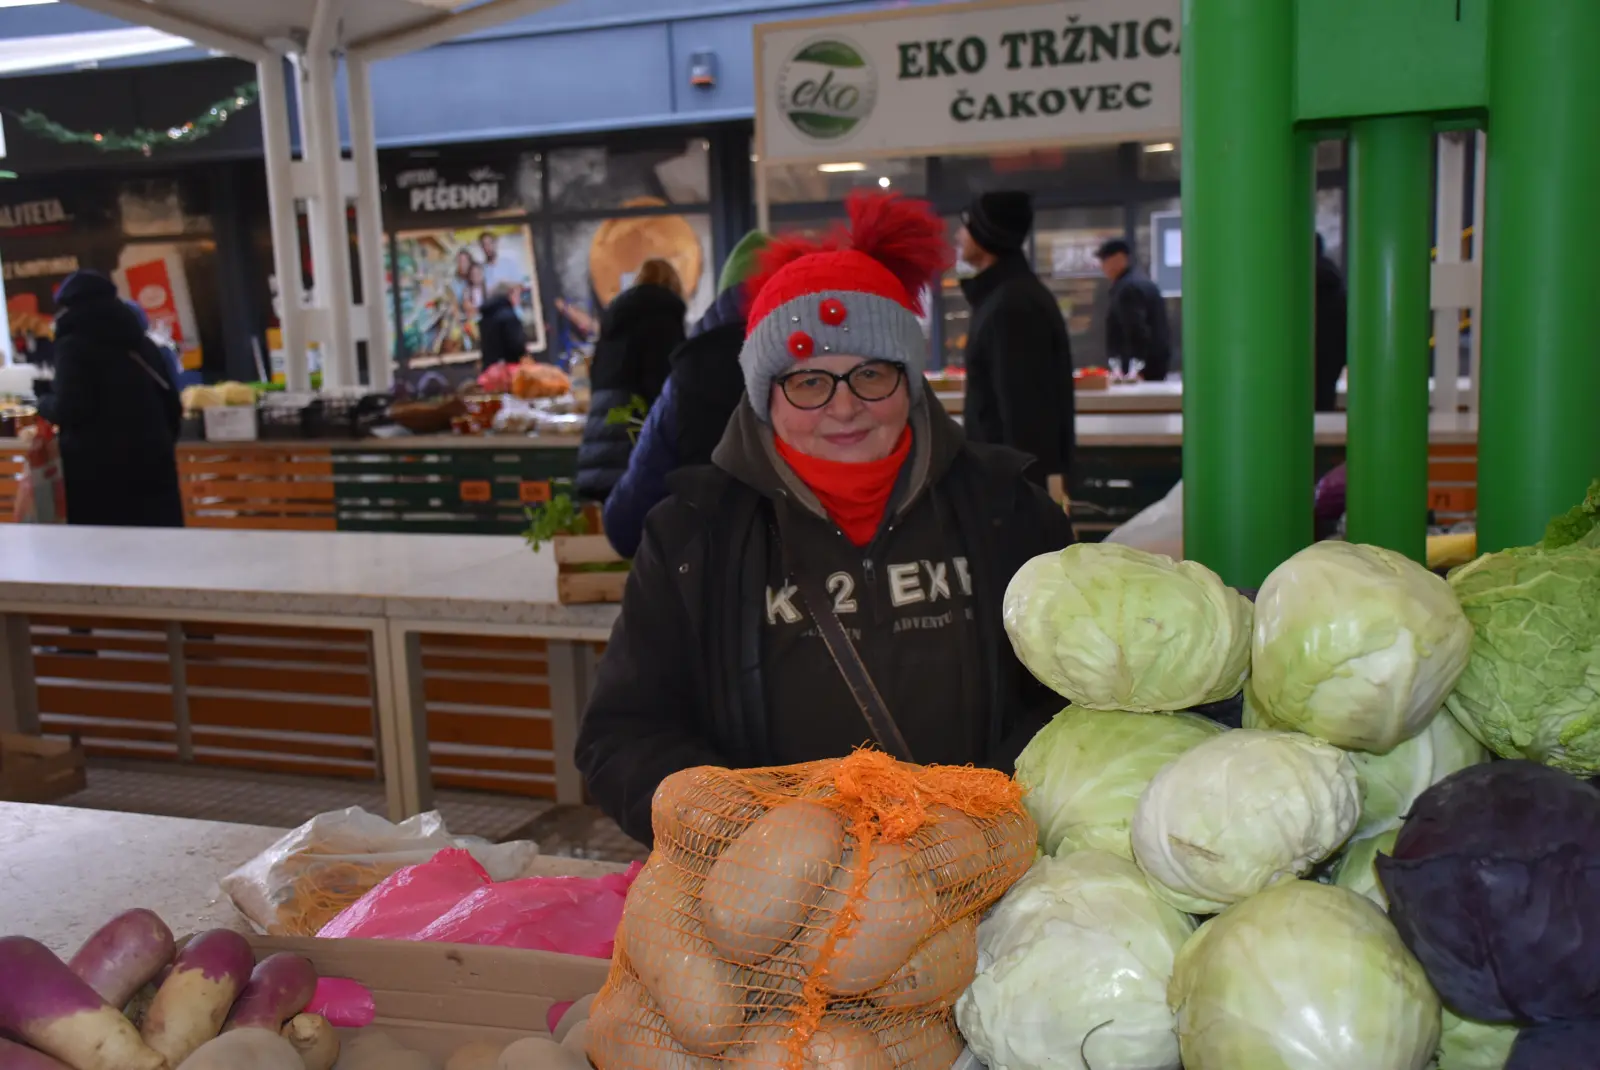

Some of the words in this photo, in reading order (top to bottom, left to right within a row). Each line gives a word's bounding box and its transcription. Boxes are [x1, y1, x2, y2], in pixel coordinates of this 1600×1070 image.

[898, 37, 987, 80] EKO
[1001, 15, 1181, 68] TRŽNIC
[792, 70, 860, 110] eko
[950, 82, 1152, 123] ČAKOVEC
